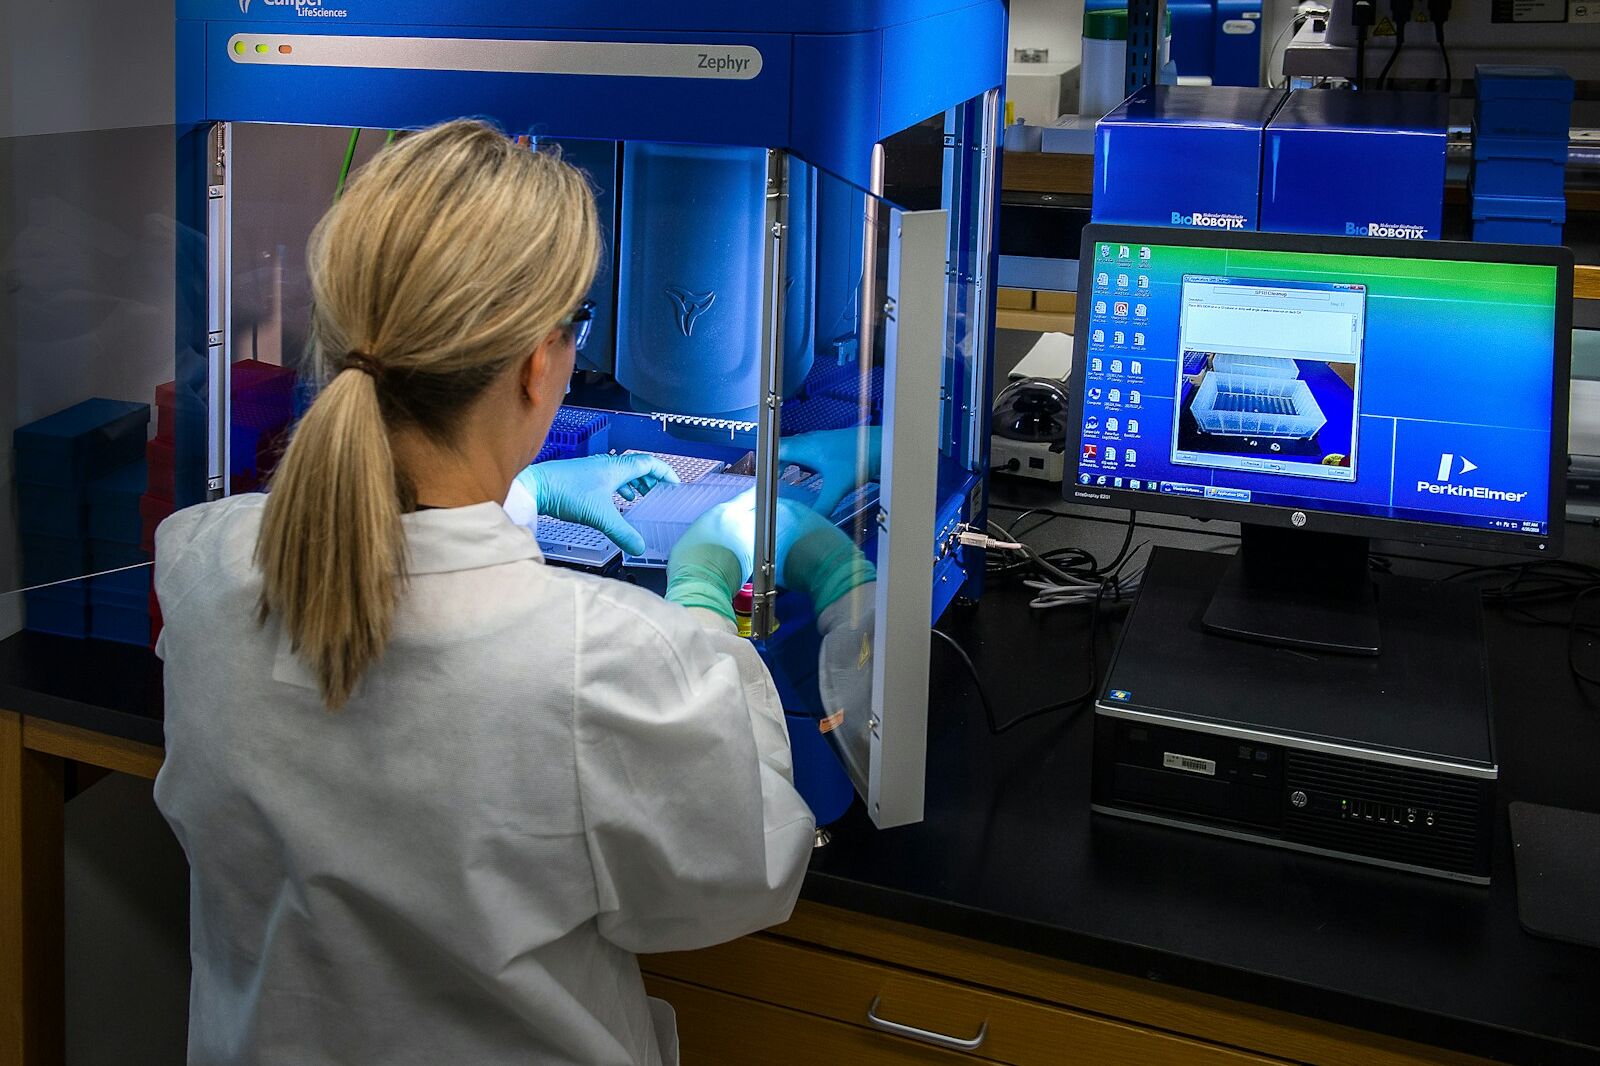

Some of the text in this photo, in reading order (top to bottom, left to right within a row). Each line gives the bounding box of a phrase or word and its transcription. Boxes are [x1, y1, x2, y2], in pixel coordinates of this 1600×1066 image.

[298, 7, 347, 17] LifeSciences
[697, 54, 751, 73] Zephyr
[1417, 481, 1526, 502] PerkinElmer
